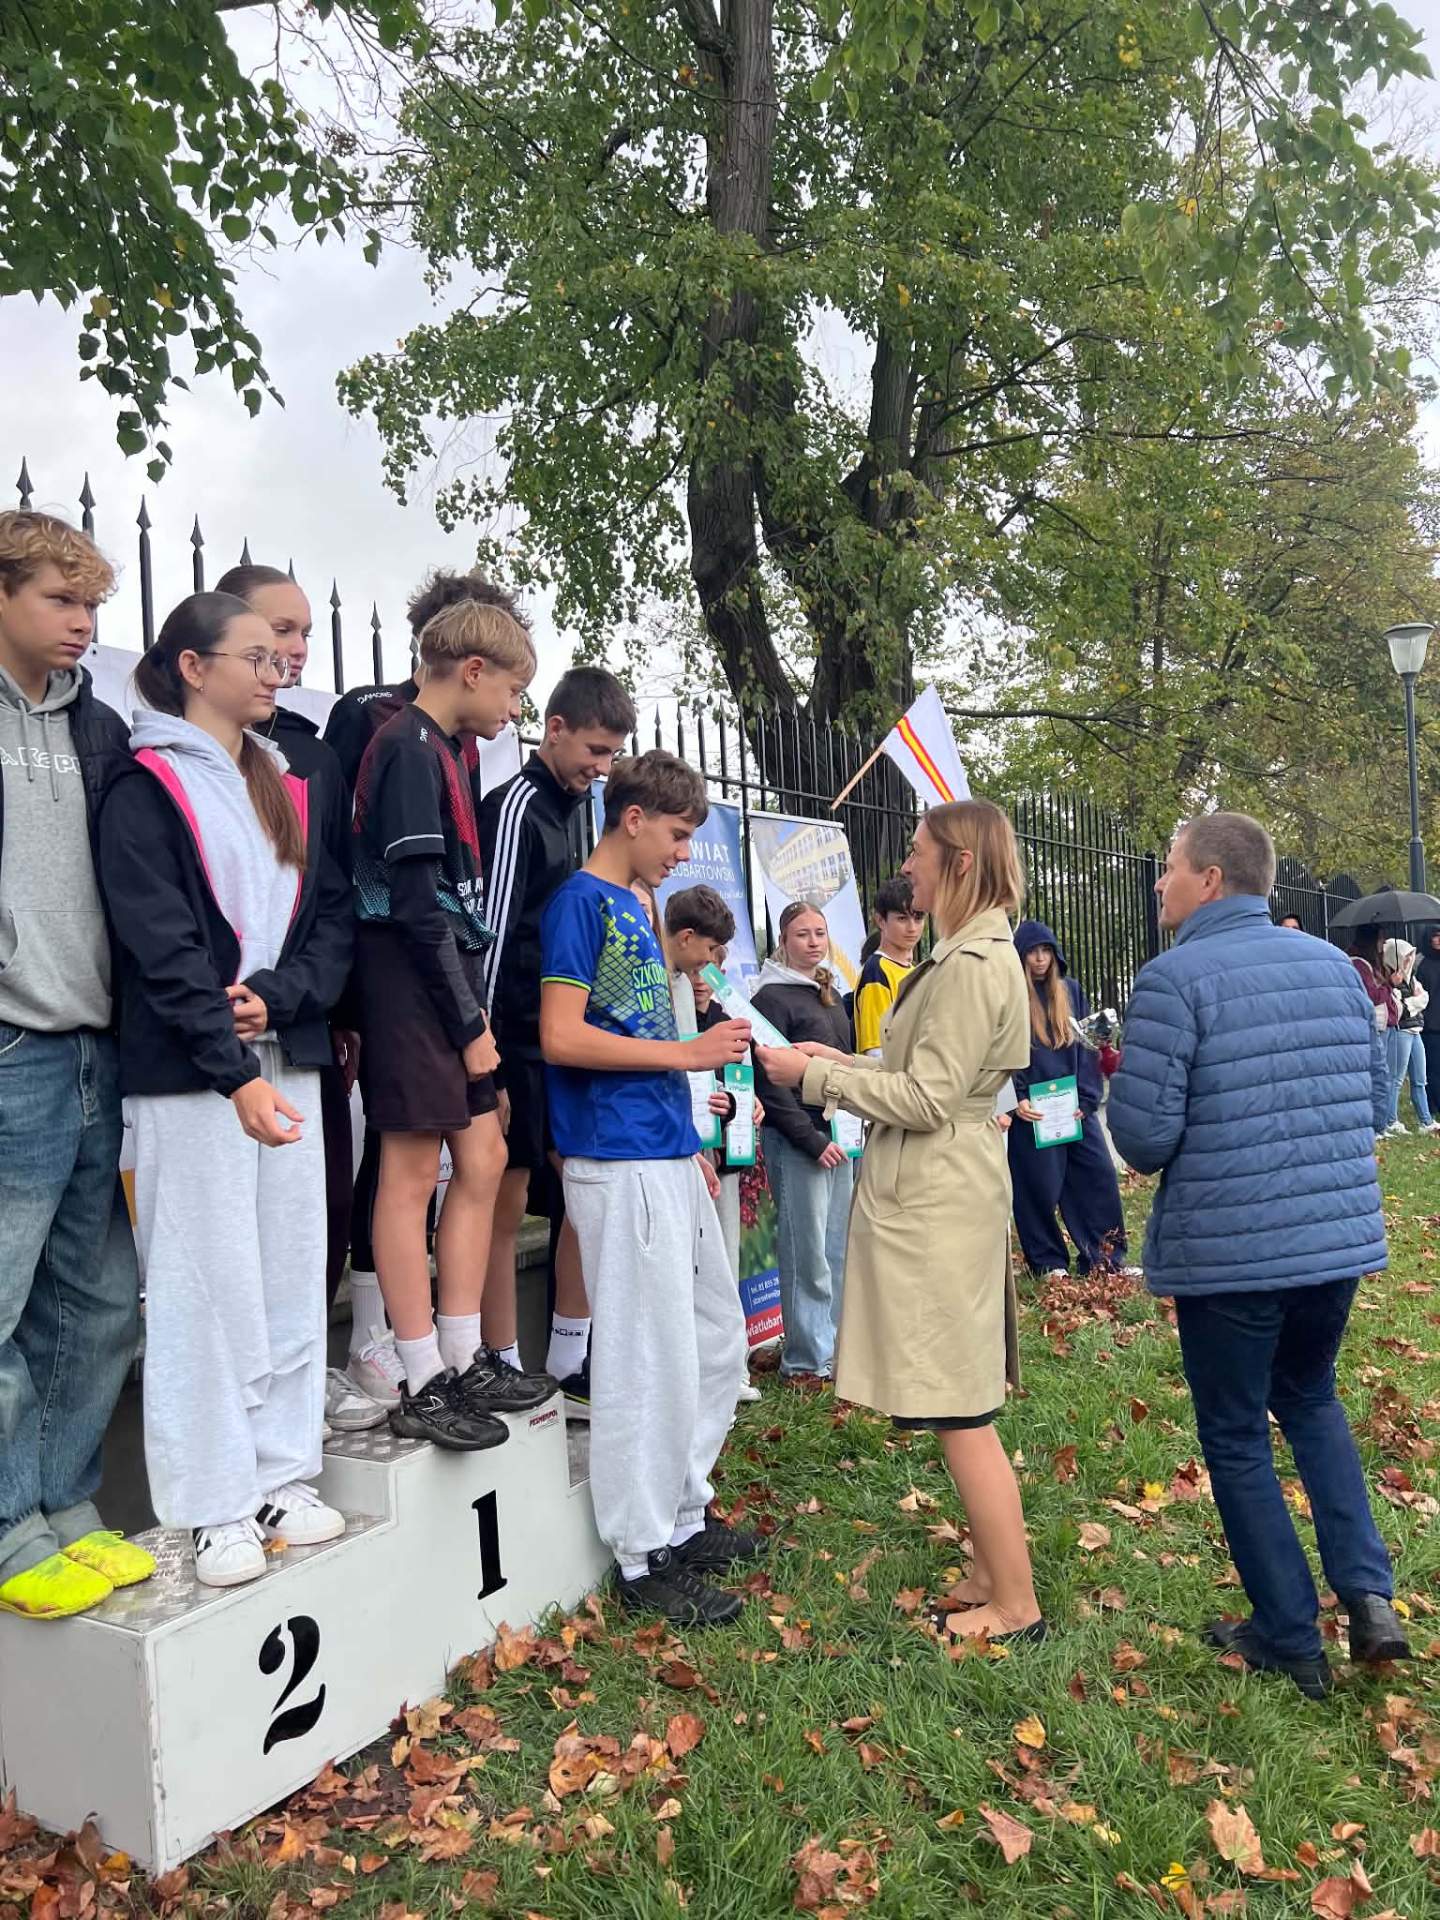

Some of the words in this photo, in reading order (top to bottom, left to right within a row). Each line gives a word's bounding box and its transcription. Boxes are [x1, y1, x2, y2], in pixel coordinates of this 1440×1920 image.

[689, 838, 730, 863] WIAT
[471, 1489, 508, 1600] 1
[258, 1615, 326, 1755] 2
